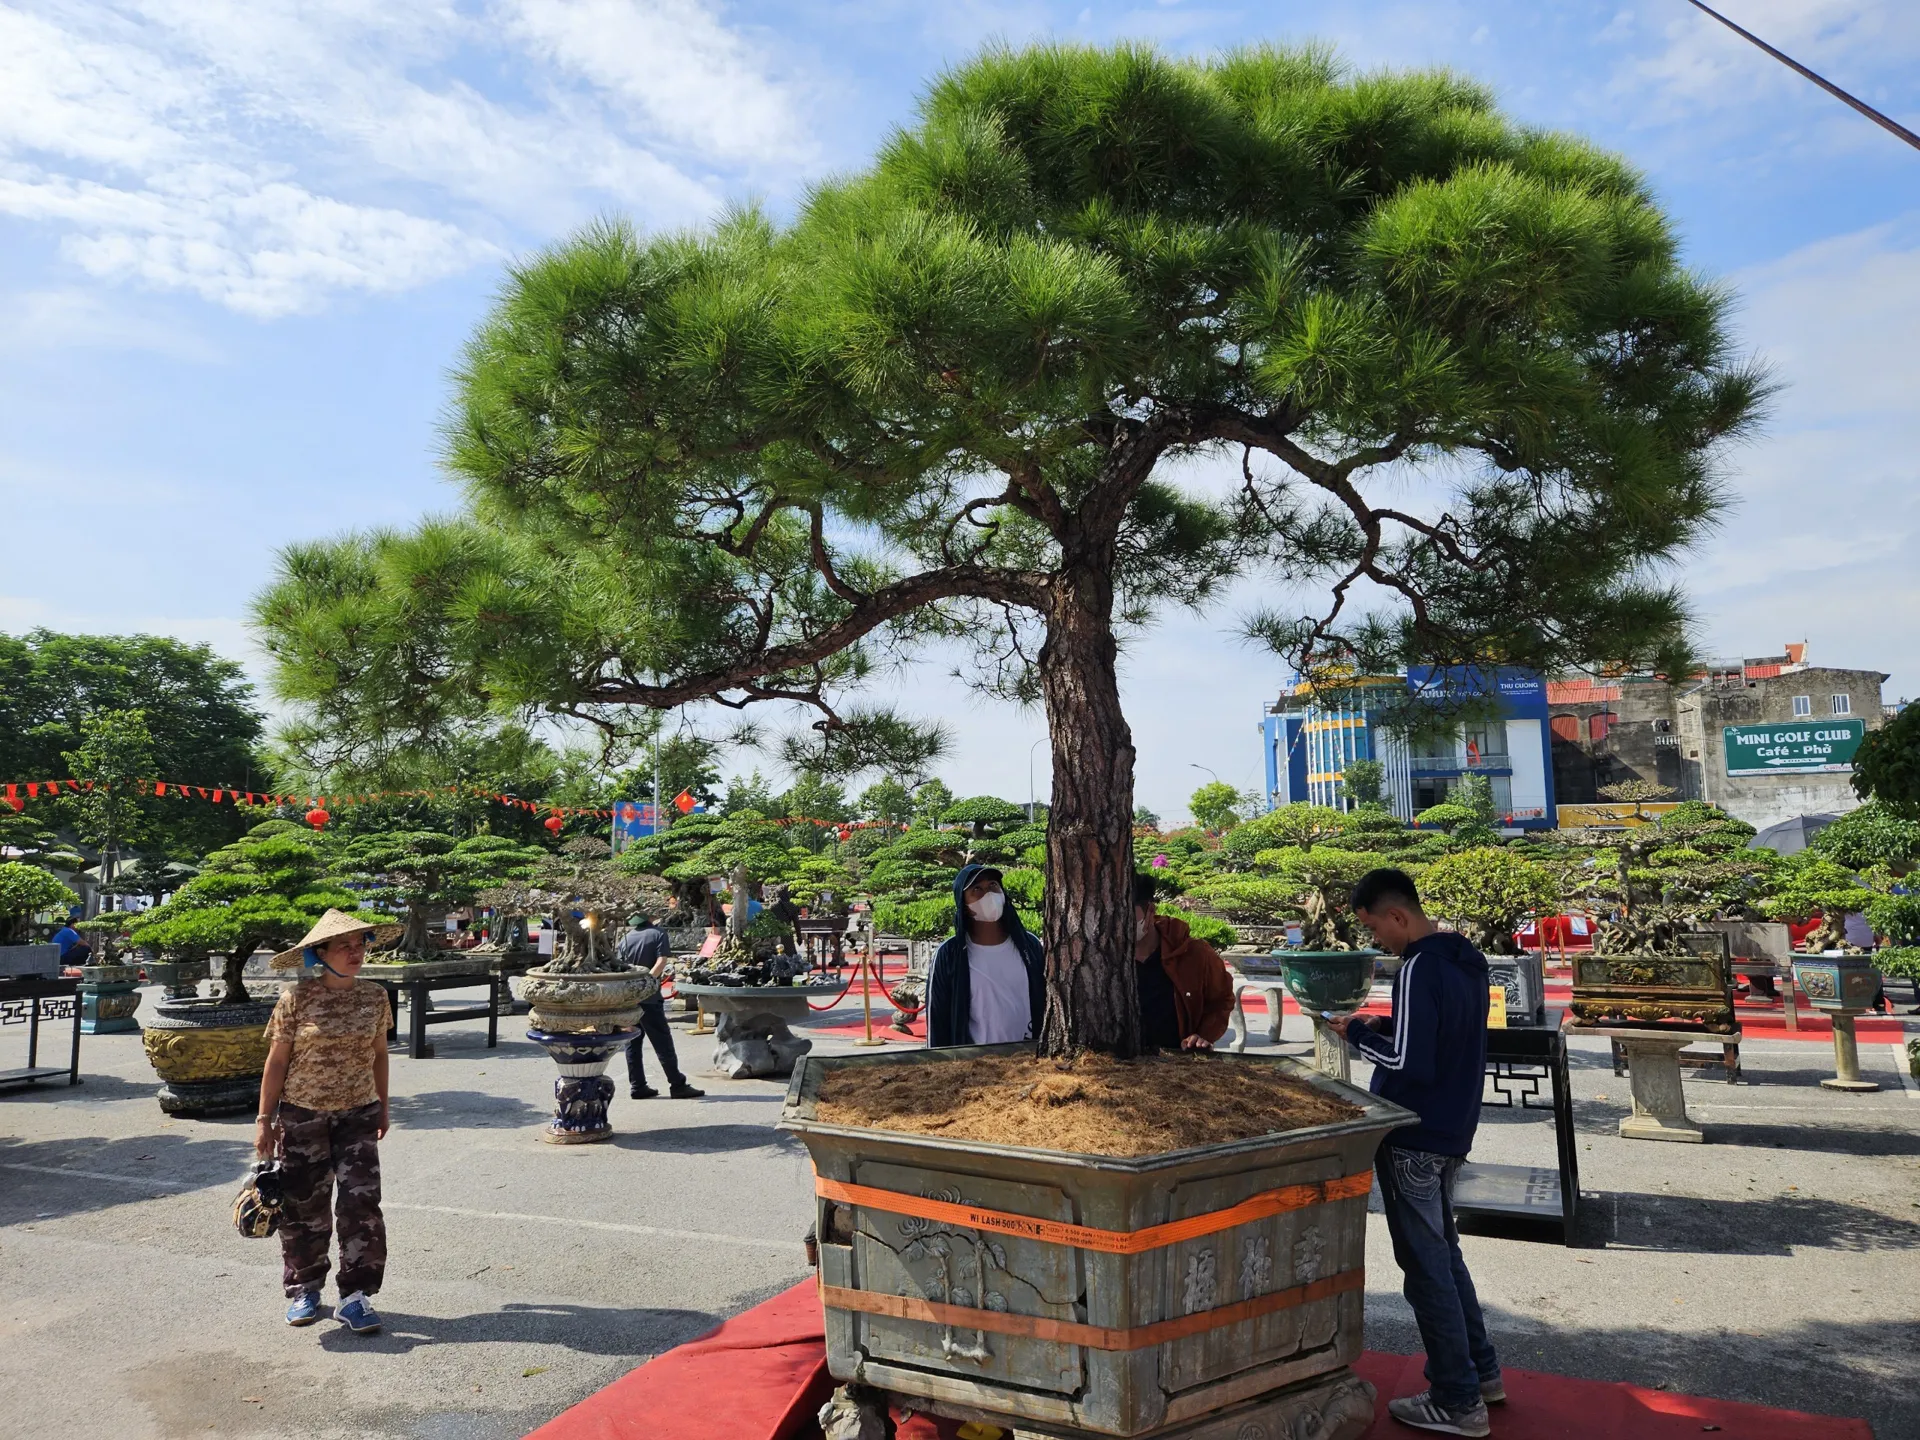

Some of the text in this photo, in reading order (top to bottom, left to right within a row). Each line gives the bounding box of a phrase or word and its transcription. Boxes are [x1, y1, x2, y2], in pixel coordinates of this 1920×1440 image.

[1736, 729, 1851, 745] MINI GOLF CLUB
[1756, 746, 1789, 757] Café
[970, 1213, 979, 1222] WI
[981, 1215, 1000, 1226] LASH
